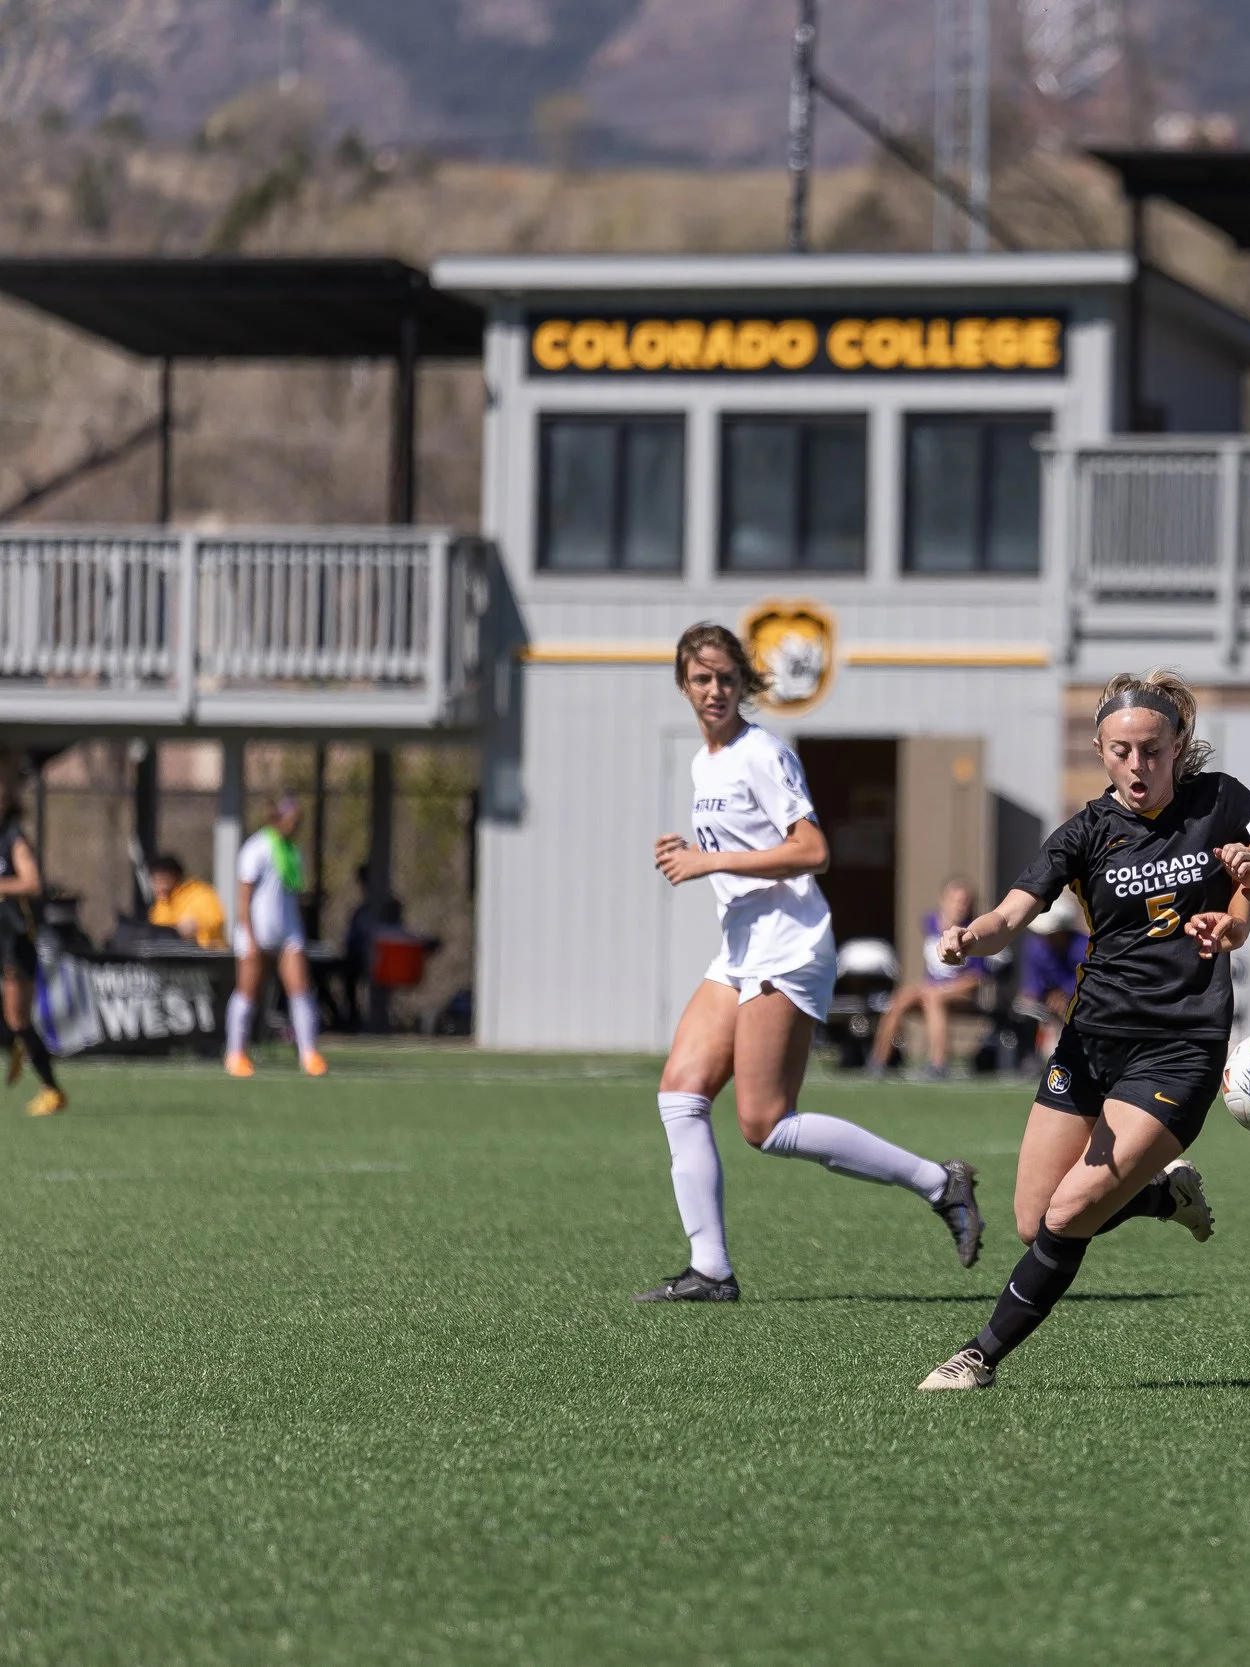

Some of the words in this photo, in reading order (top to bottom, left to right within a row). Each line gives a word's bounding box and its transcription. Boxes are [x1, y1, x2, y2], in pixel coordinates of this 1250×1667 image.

[532, 320, 818, 370] COLORADO
[826, 318, 1062, 369] COLLEGE
[1105, 851, 1209, 884] COLORADO
[1115, 867, 1203, 898] COLLEGE
[1145, 892, 1181, 938] 5
[97, 992, 215, 1041] WEST
